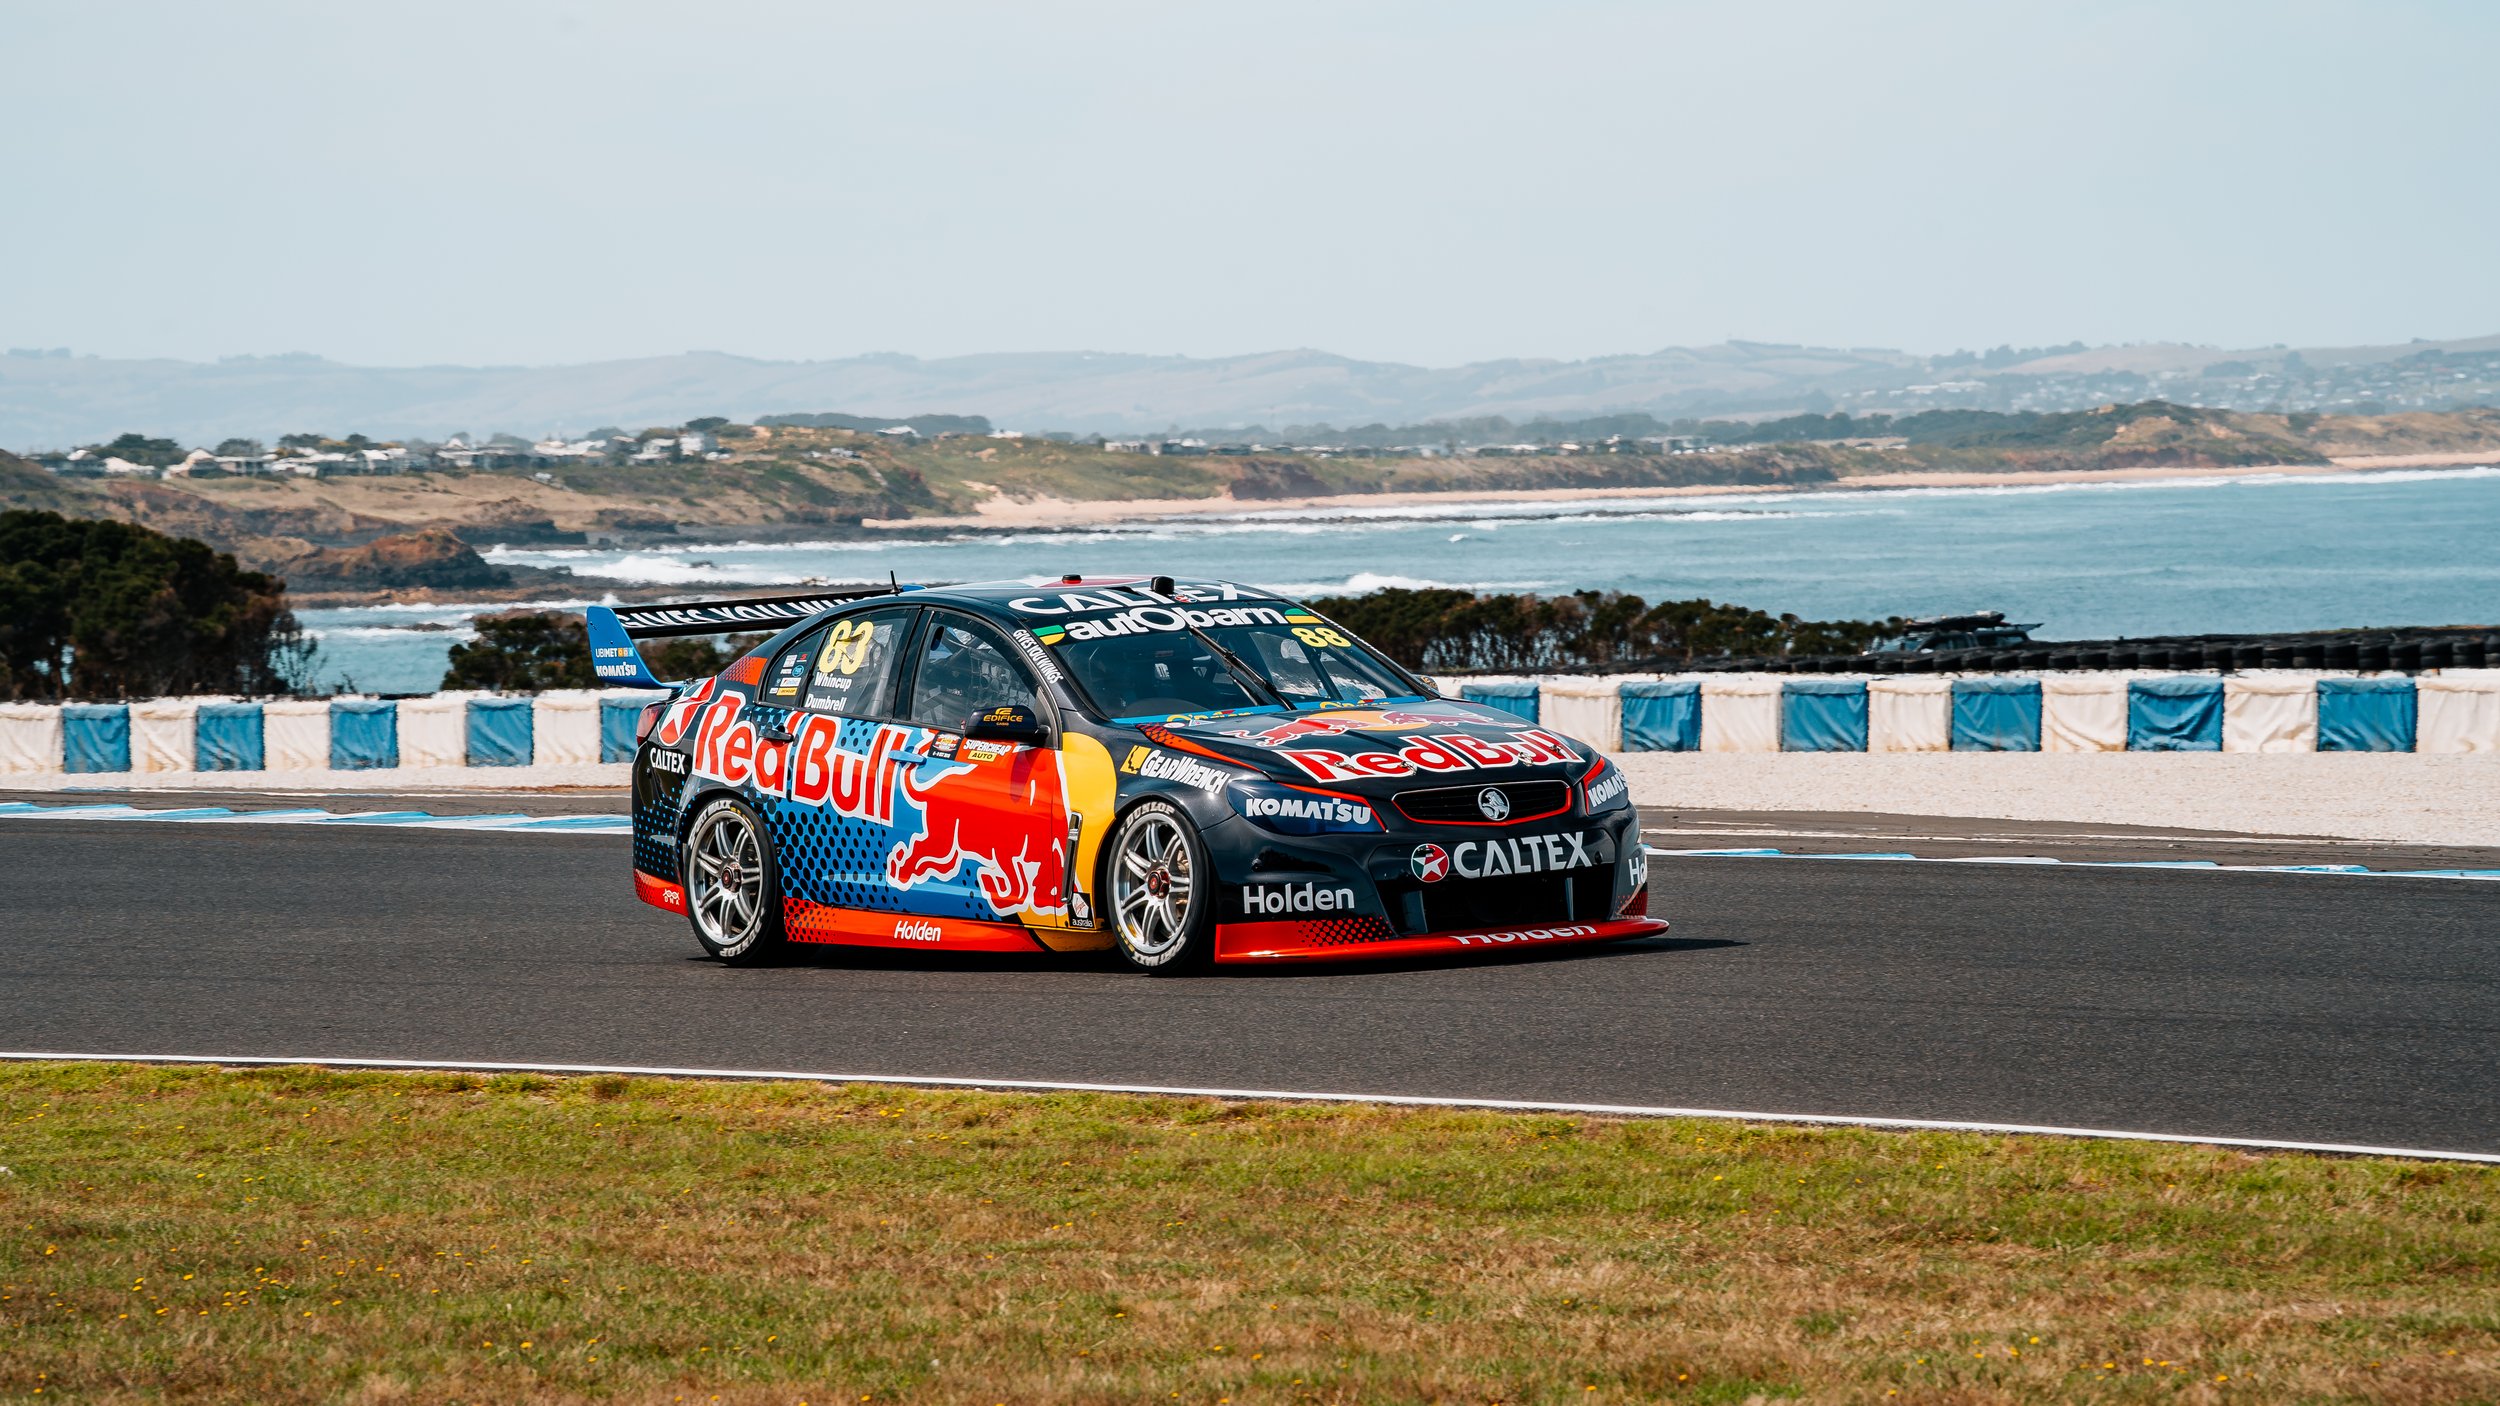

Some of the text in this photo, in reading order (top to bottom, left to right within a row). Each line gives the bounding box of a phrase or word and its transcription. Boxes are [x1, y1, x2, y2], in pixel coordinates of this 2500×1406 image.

[1008, 583, 1269, 615] CALTEX
[1291, 627, 1351, 648] 88
[1013, 629, 1064, 684] GIVES YOU WINGS
[596, 661, 637, 677] KOMATSU
[814, 672, 853, 692] Whincup
[805, 693, 847, 711] Dumbrell
[983, 714, 1023, 722] EDIFICE
[963, 739, 1012, 756] SUPERCHEAP
[650, 747, 686, 775] CALTEX
[1126, 801, 1175, 829] DUNLOP
[1246, 798, 1371, 825] KOMATSU
[1453, 831, 1593, 879] CALTEX
[1243, 881, 1355, 914] Holden
[894, 920, 942, 942] Holden
